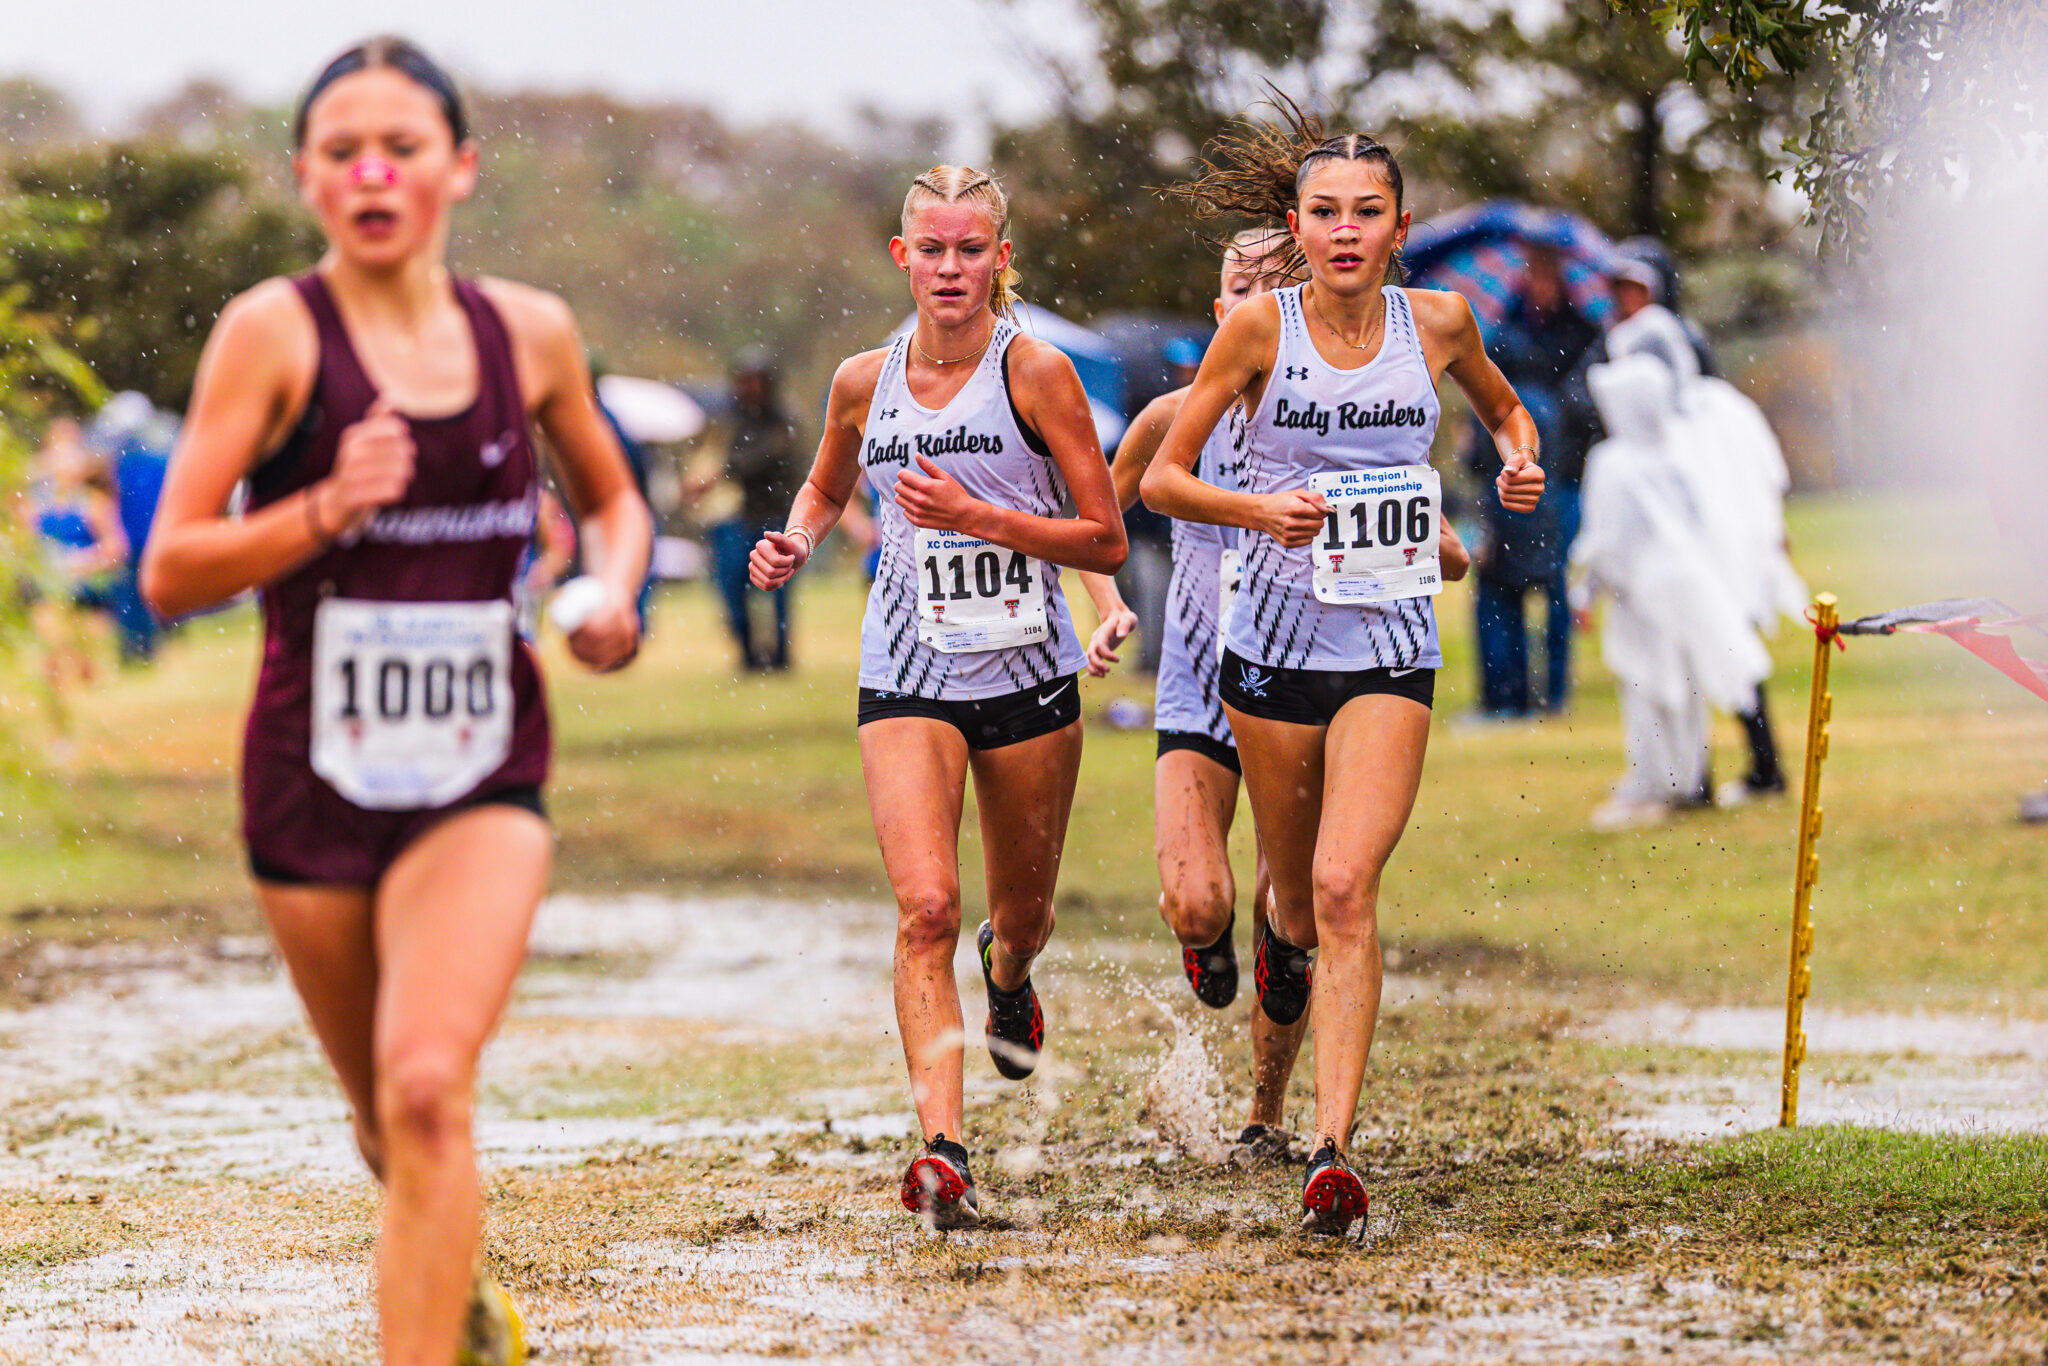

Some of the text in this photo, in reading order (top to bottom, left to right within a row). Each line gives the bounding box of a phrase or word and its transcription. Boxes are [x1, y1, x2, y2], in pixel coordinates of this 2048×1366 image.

[1273, 398, 1426, 437] Lady Raiders
[866, 425, 1004, 467] Lady Raiders
[1326, 481, 1423, 498] XC Championship
[1340, 474, 1360, 484] UIL
[1363, 471, 1401, 482] Region
[1323, 496, 1431, 551] 1106
[927, 539, 992, 549] XC Champio
[924, 551, 1033, 601] 1104
[1418, 575, 1436, 585] 1106
[1024, 625, 1042, 635] 1104
[340, 657, 495, 718] 1000
